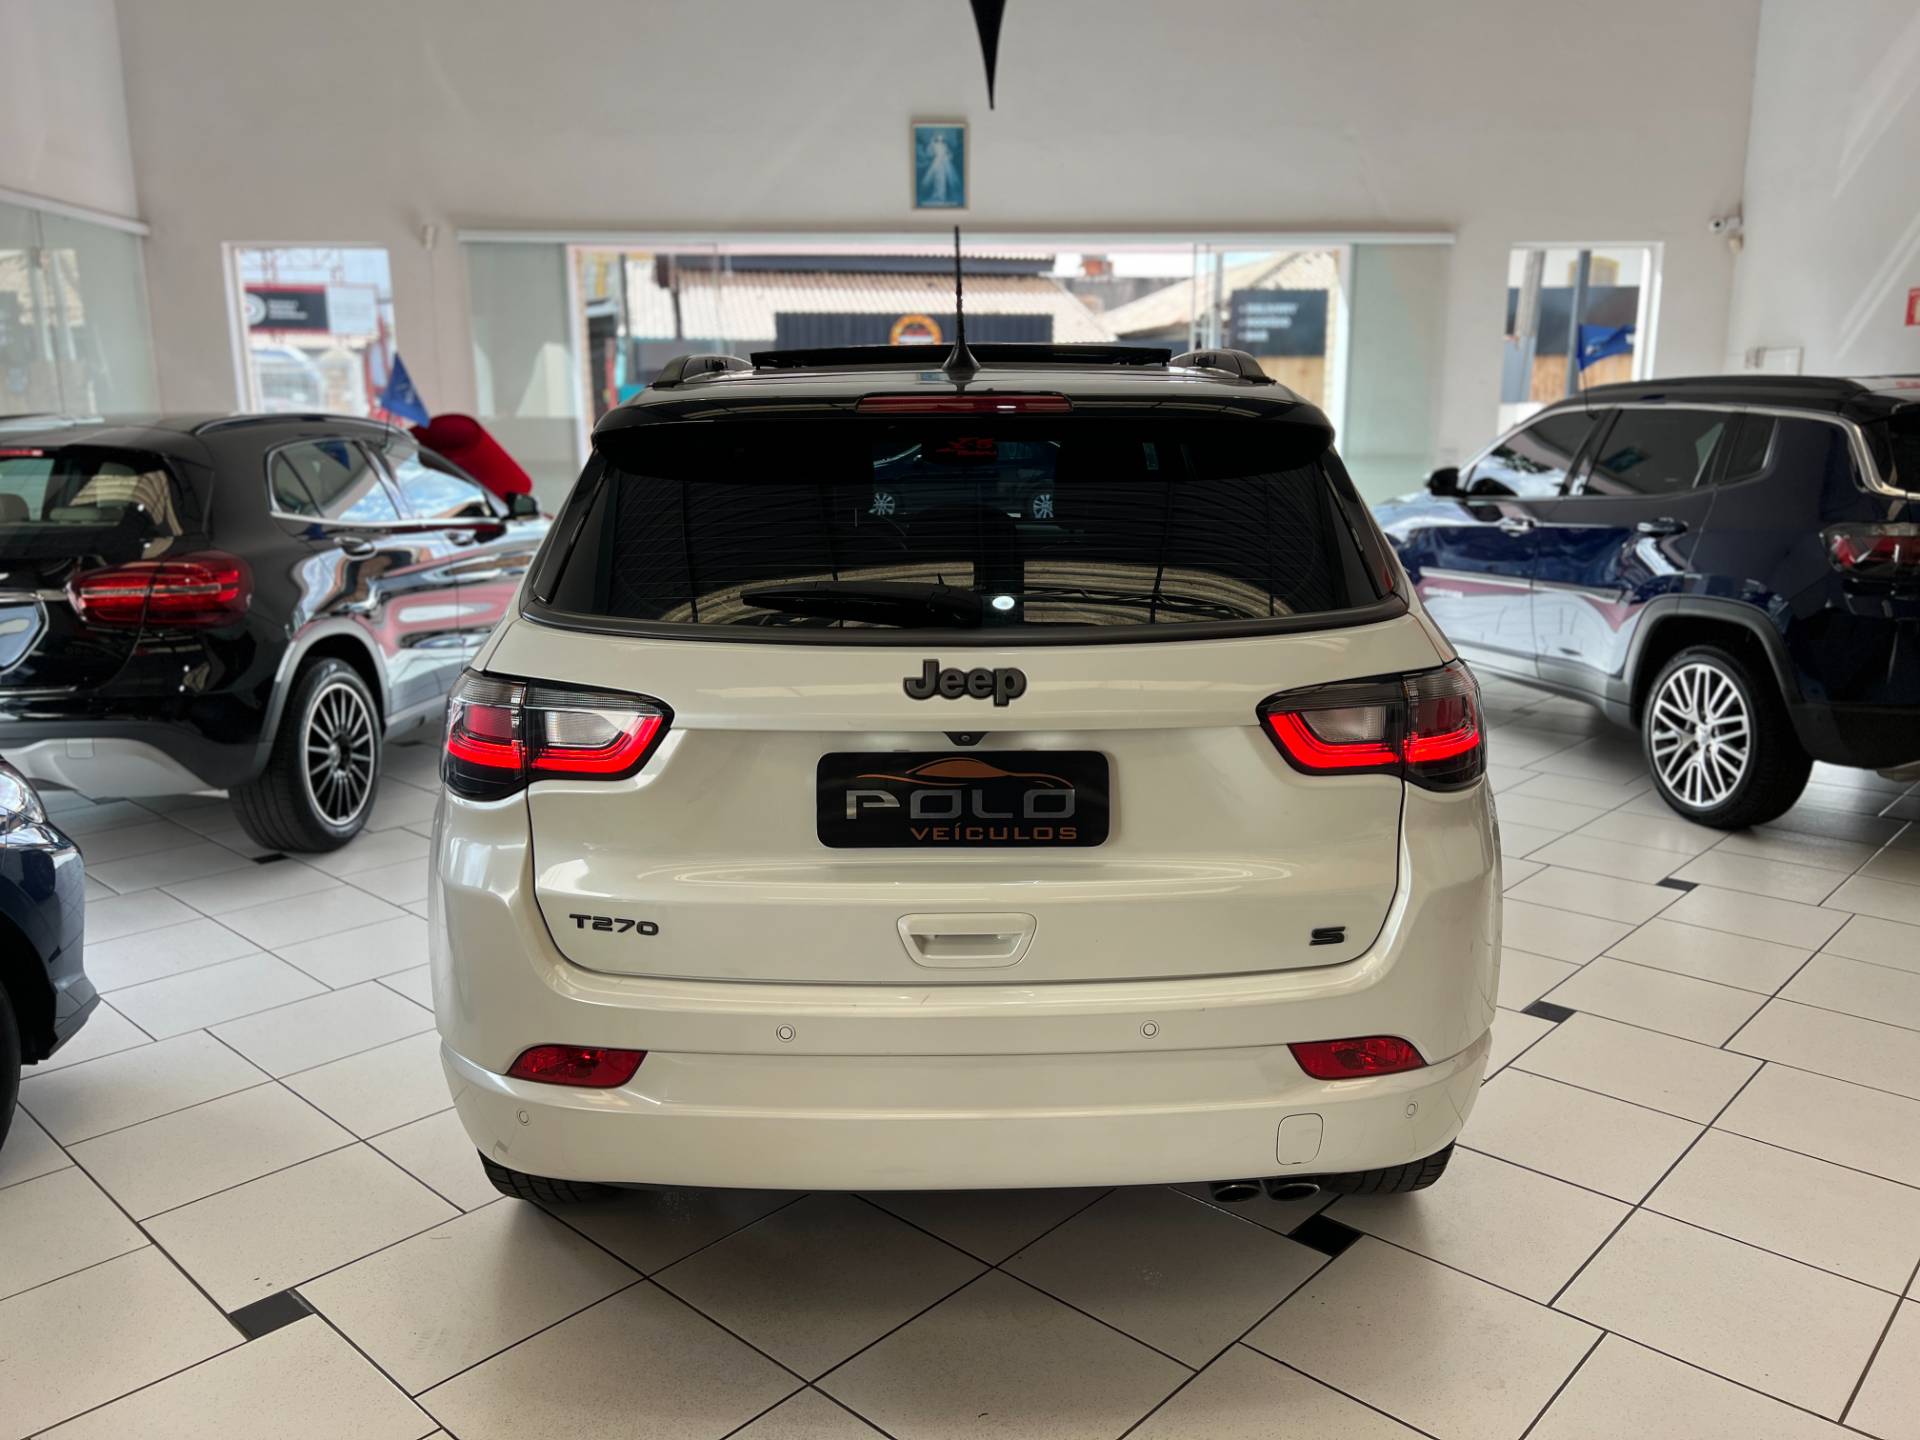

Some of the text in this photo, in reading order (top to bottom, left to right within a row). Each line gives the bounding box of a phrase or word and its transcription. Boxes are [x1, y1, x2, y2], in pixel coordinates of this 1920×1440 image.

[903, 659, 1027, 707] Jeep
[846, 789, 1076, 820] POLO
[910, 823, 1078, 841] VEÍCULOS
[569, 913, 659, 936] T270
[1309, 926, 1346, 946] S
